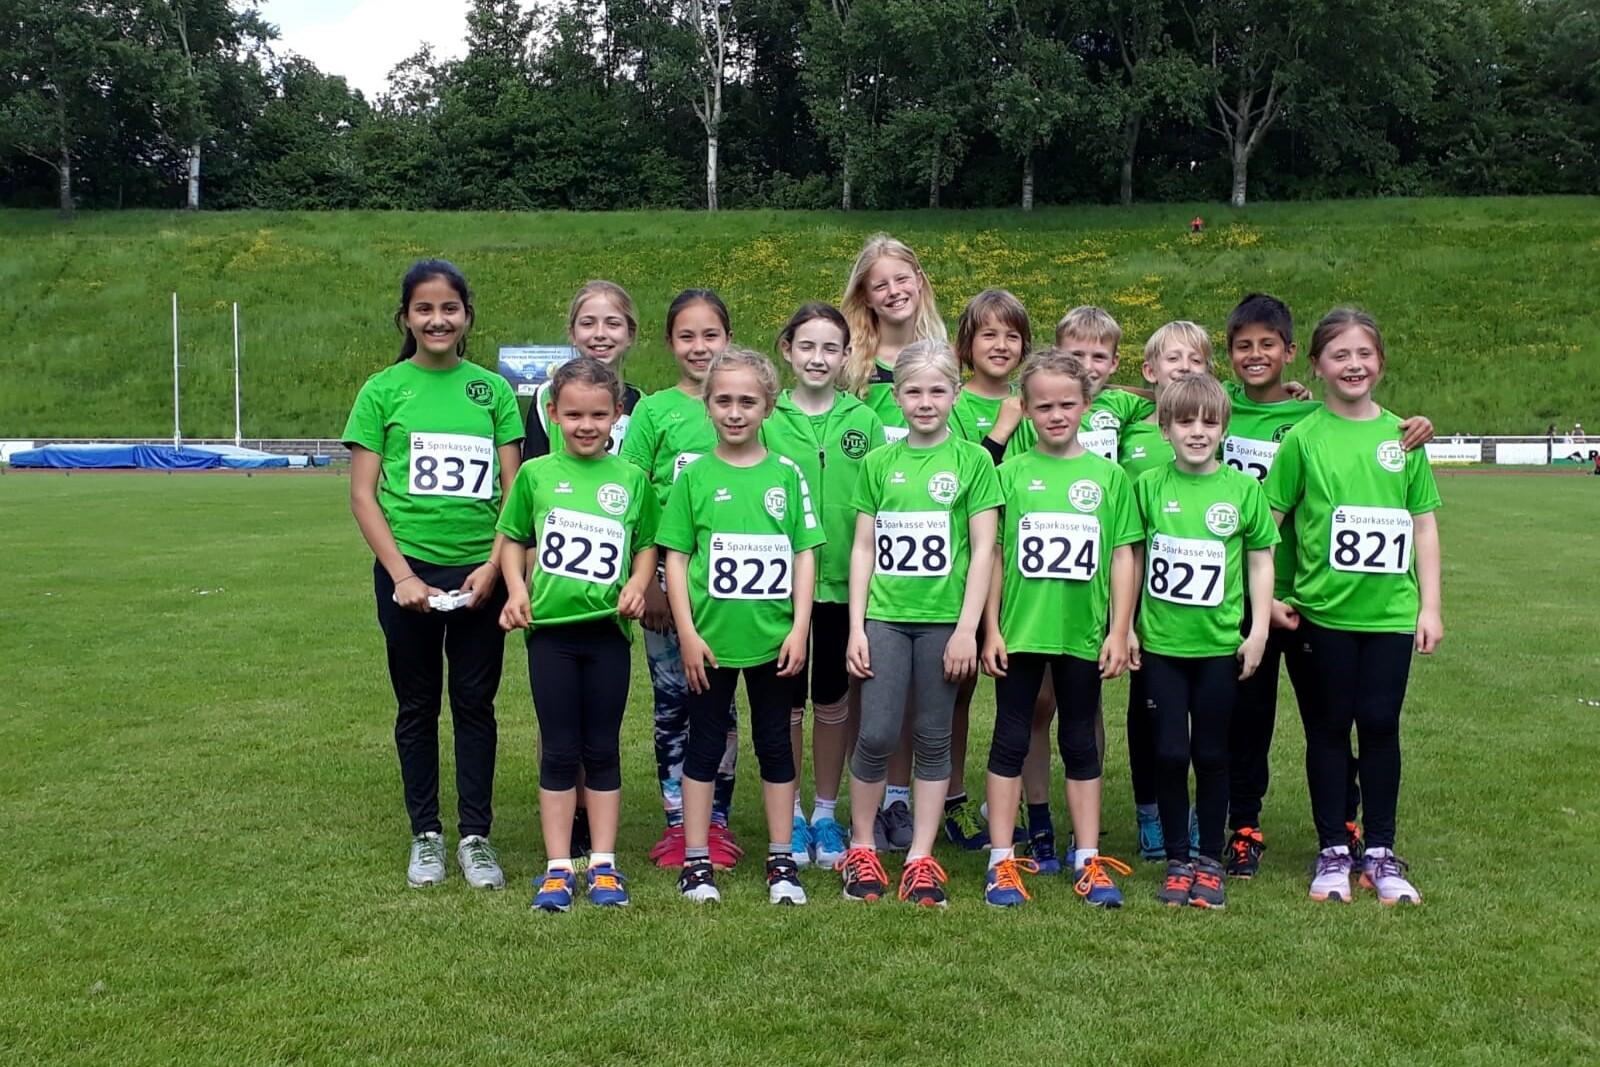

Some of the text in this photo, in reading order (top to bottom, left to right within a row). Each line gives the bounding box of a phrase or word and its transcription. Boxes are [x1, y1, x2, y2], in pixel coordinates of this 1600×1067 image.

[428, 441, 473, 452] Sparkasse
[475, 444, 491, 455] Vest
[844, 437, 866, 449] TUS
[414, 456, 489, 494] 837
[930, 481, 956, 492] TUS
[603, 492, 626, 504] TUS
[1072, 489, 1098, 500] TUS
[884, 520, 924, 530] Sparkasse
[926, 520, 946, 528] Vest
[1210, 513, 1236, 524] TUS
[1350, 515, 1394, 526] Sparkasse
[1396, 517, 1412, 527] Vest
[559, 517, 604, 534] Sparkasse
[606, 528, 623, 540] Vest
[1034, 521, 1080, 533] Sparkasse
[1082, 523, 1098, 534] Vest
[727, 542, 773, 552] Sparkasse
[774, 543, 790, 552] Vest
[878, 535, 947, 572] 828
[1161, 543, 1204, 558] Sparkasse
[1206, 549, 1223, 558] Vest
[1334, 529, 1406, 569] 821
[542, 531, 619, 579] 823
[1022, 536, 1096, 576] 824
[713, 557, 788, 595] 822
[1150, 557, 1221, 601] 827
